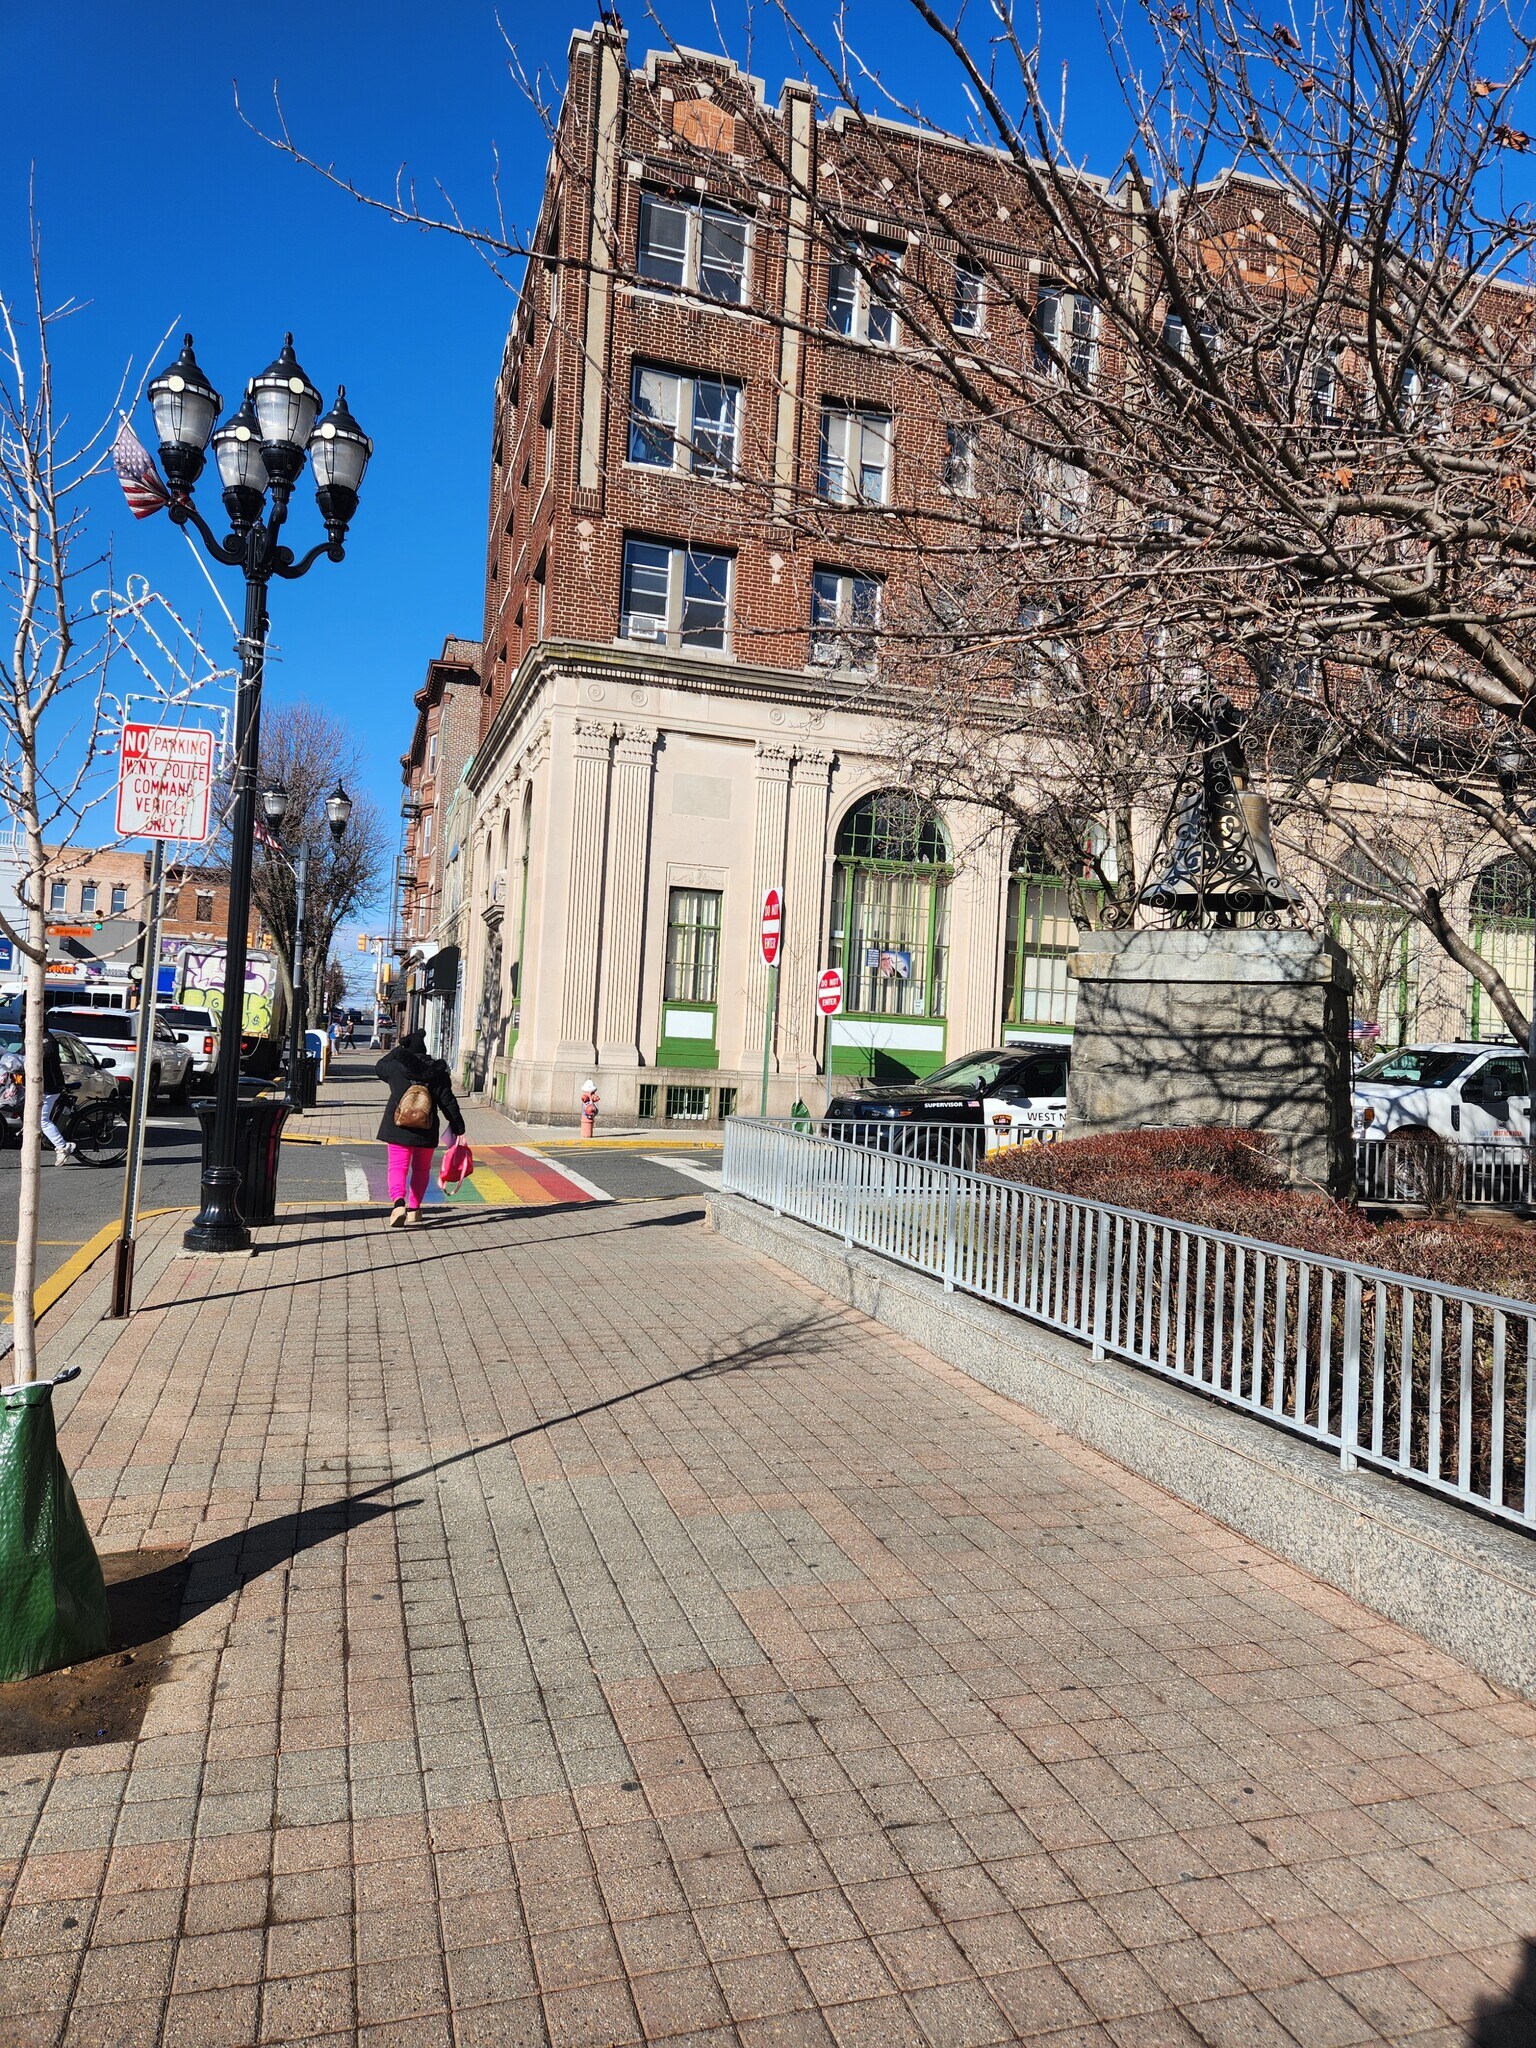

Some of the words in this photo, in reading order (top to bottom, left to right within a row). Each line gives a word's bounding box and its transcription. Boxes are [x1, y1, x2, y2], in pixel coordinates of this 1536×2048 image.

[125, 731, 149, 753] NO
[154, 736, 207, 756] PARKING
[126, 758, 158, 777] W.N.Y.
[164, 763, 206, 781] POLICE
[134, 778, 194, 798] COMMAND
[136, 797, 188, 817] VEHICLE
[145, 816, 177, 833] ONLY
[771, 904, 779, 916] NOT
[764, 937, 776, 949] ENTER
[821, 979, 828, 987] DO
[829, 978, 839, 986] NOT
[822, 998, 837, 1006] ENTER
[1027, 1112, 1056, 1121] WEST
